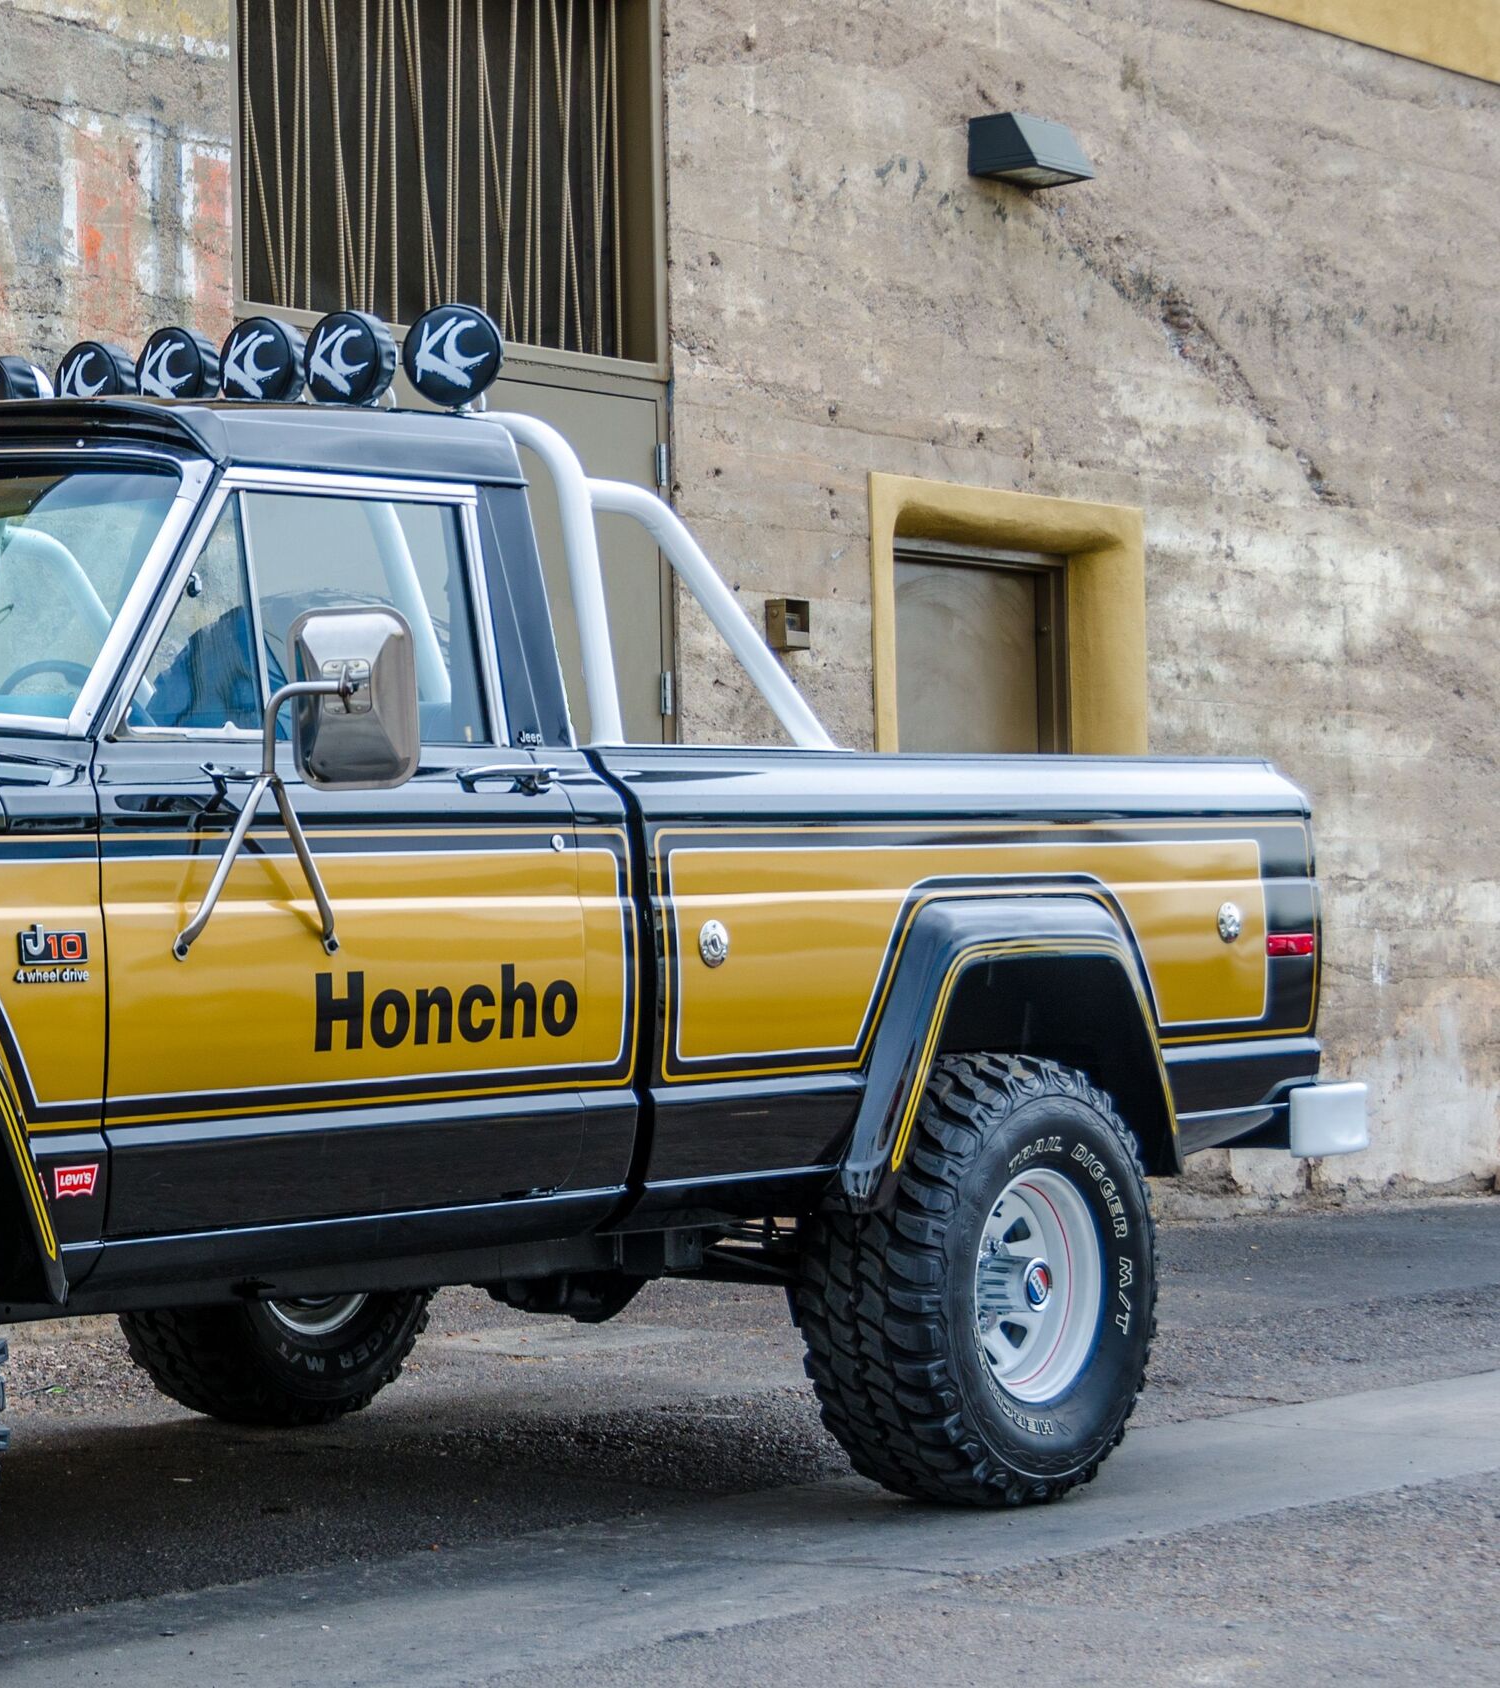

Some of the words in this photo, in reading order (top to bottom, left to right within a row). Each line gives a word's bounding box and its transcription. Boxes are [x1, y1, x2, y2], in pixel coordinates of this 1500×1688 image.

[140, 339, 193, 399] KC
[224, 330, 280, 399] KC
[309, 324, 368, 395] KC
[415, 316, 490, 389] KC
[520, 731, 542, 743] Jeep
[16, 969, 25, 983] 4
[26, 968, 59, 982] wheel
[62, 968, 89, 981] drive
[25, 924, 82, 959] J10
[314, 963, 578, 1052] Honcho
[1009, 1136, 1063, 1174] TRAIL
[1070, 1143, 1128, 1239] DIGGER
[1115, 1256, 1133, 1335] M/T
